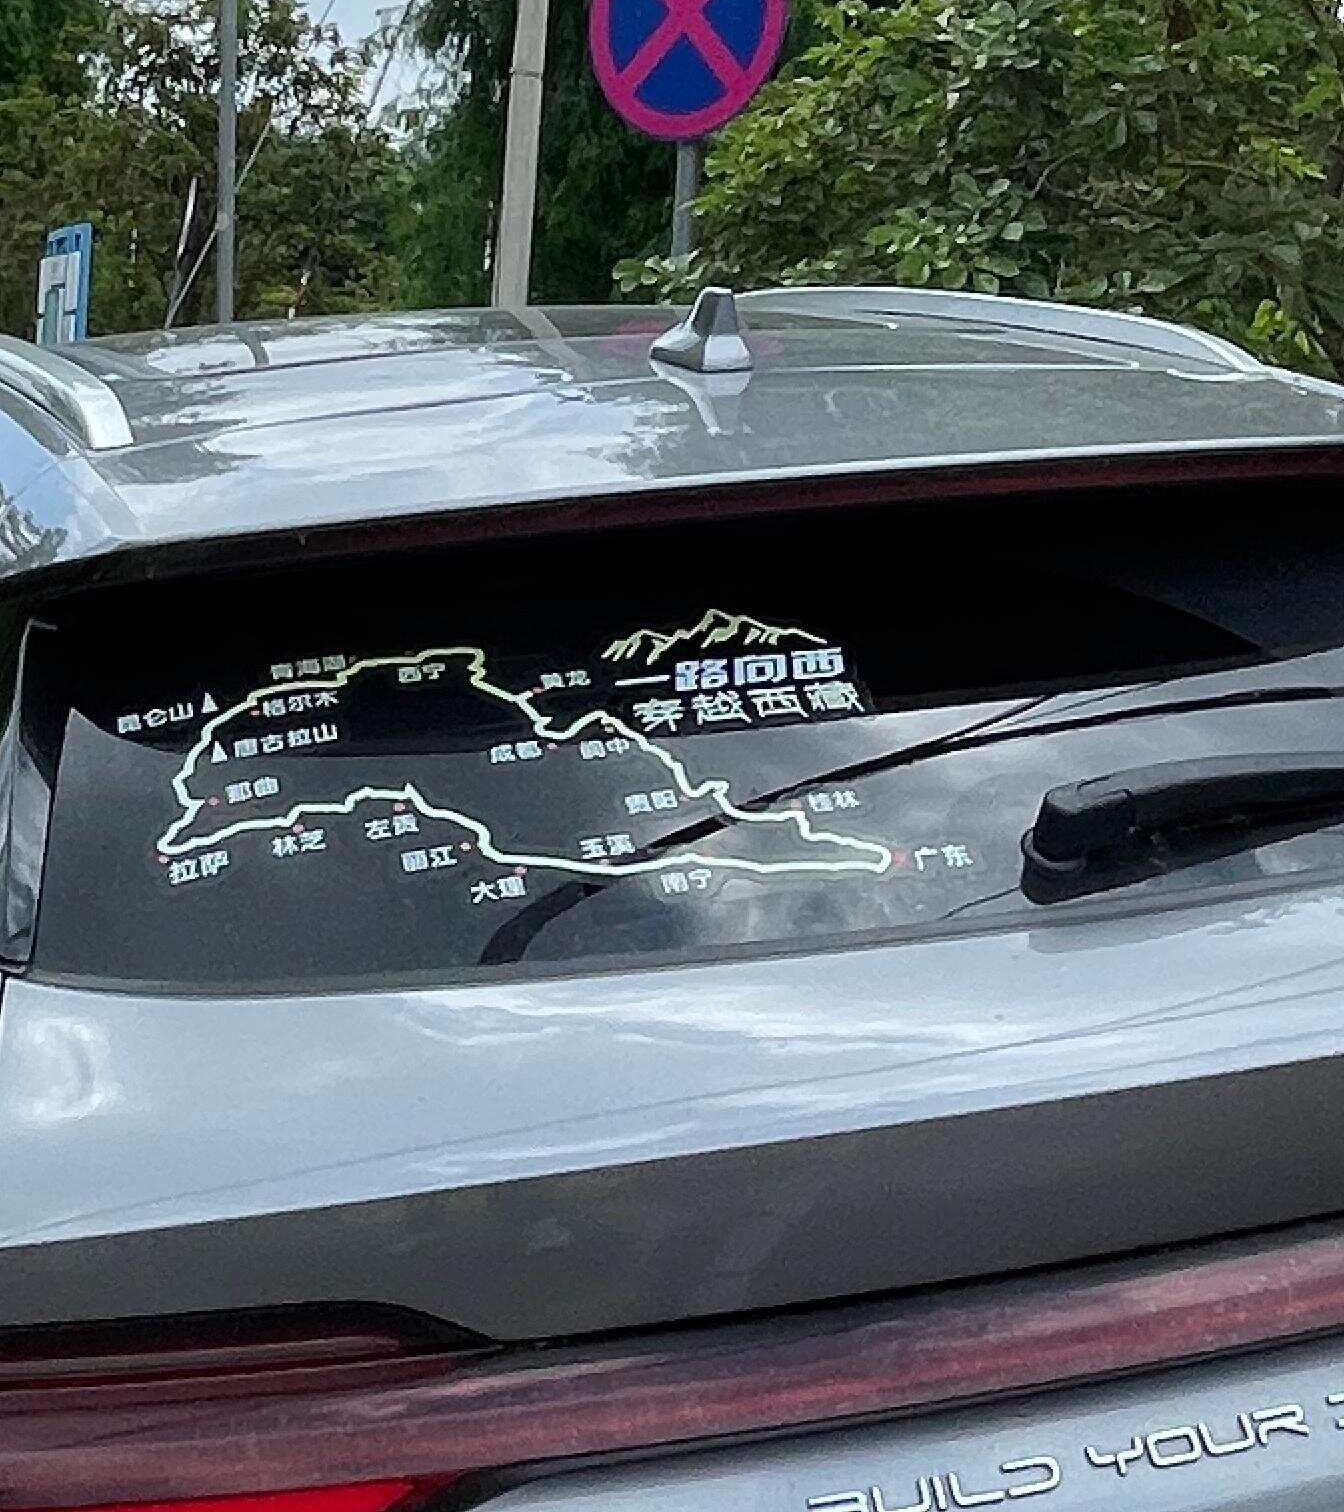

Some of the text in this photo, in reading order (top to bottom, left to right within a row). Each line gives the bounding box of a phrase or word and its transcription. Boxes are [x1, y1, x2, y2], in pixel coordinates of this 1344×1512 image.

[614, 646, 845, 691] 一路向西
[632, 680, 866, 732] 穿越西藏
[914, 844, 974, 872] 广东
[1084, 1402, 1310, 1477] YOUR
